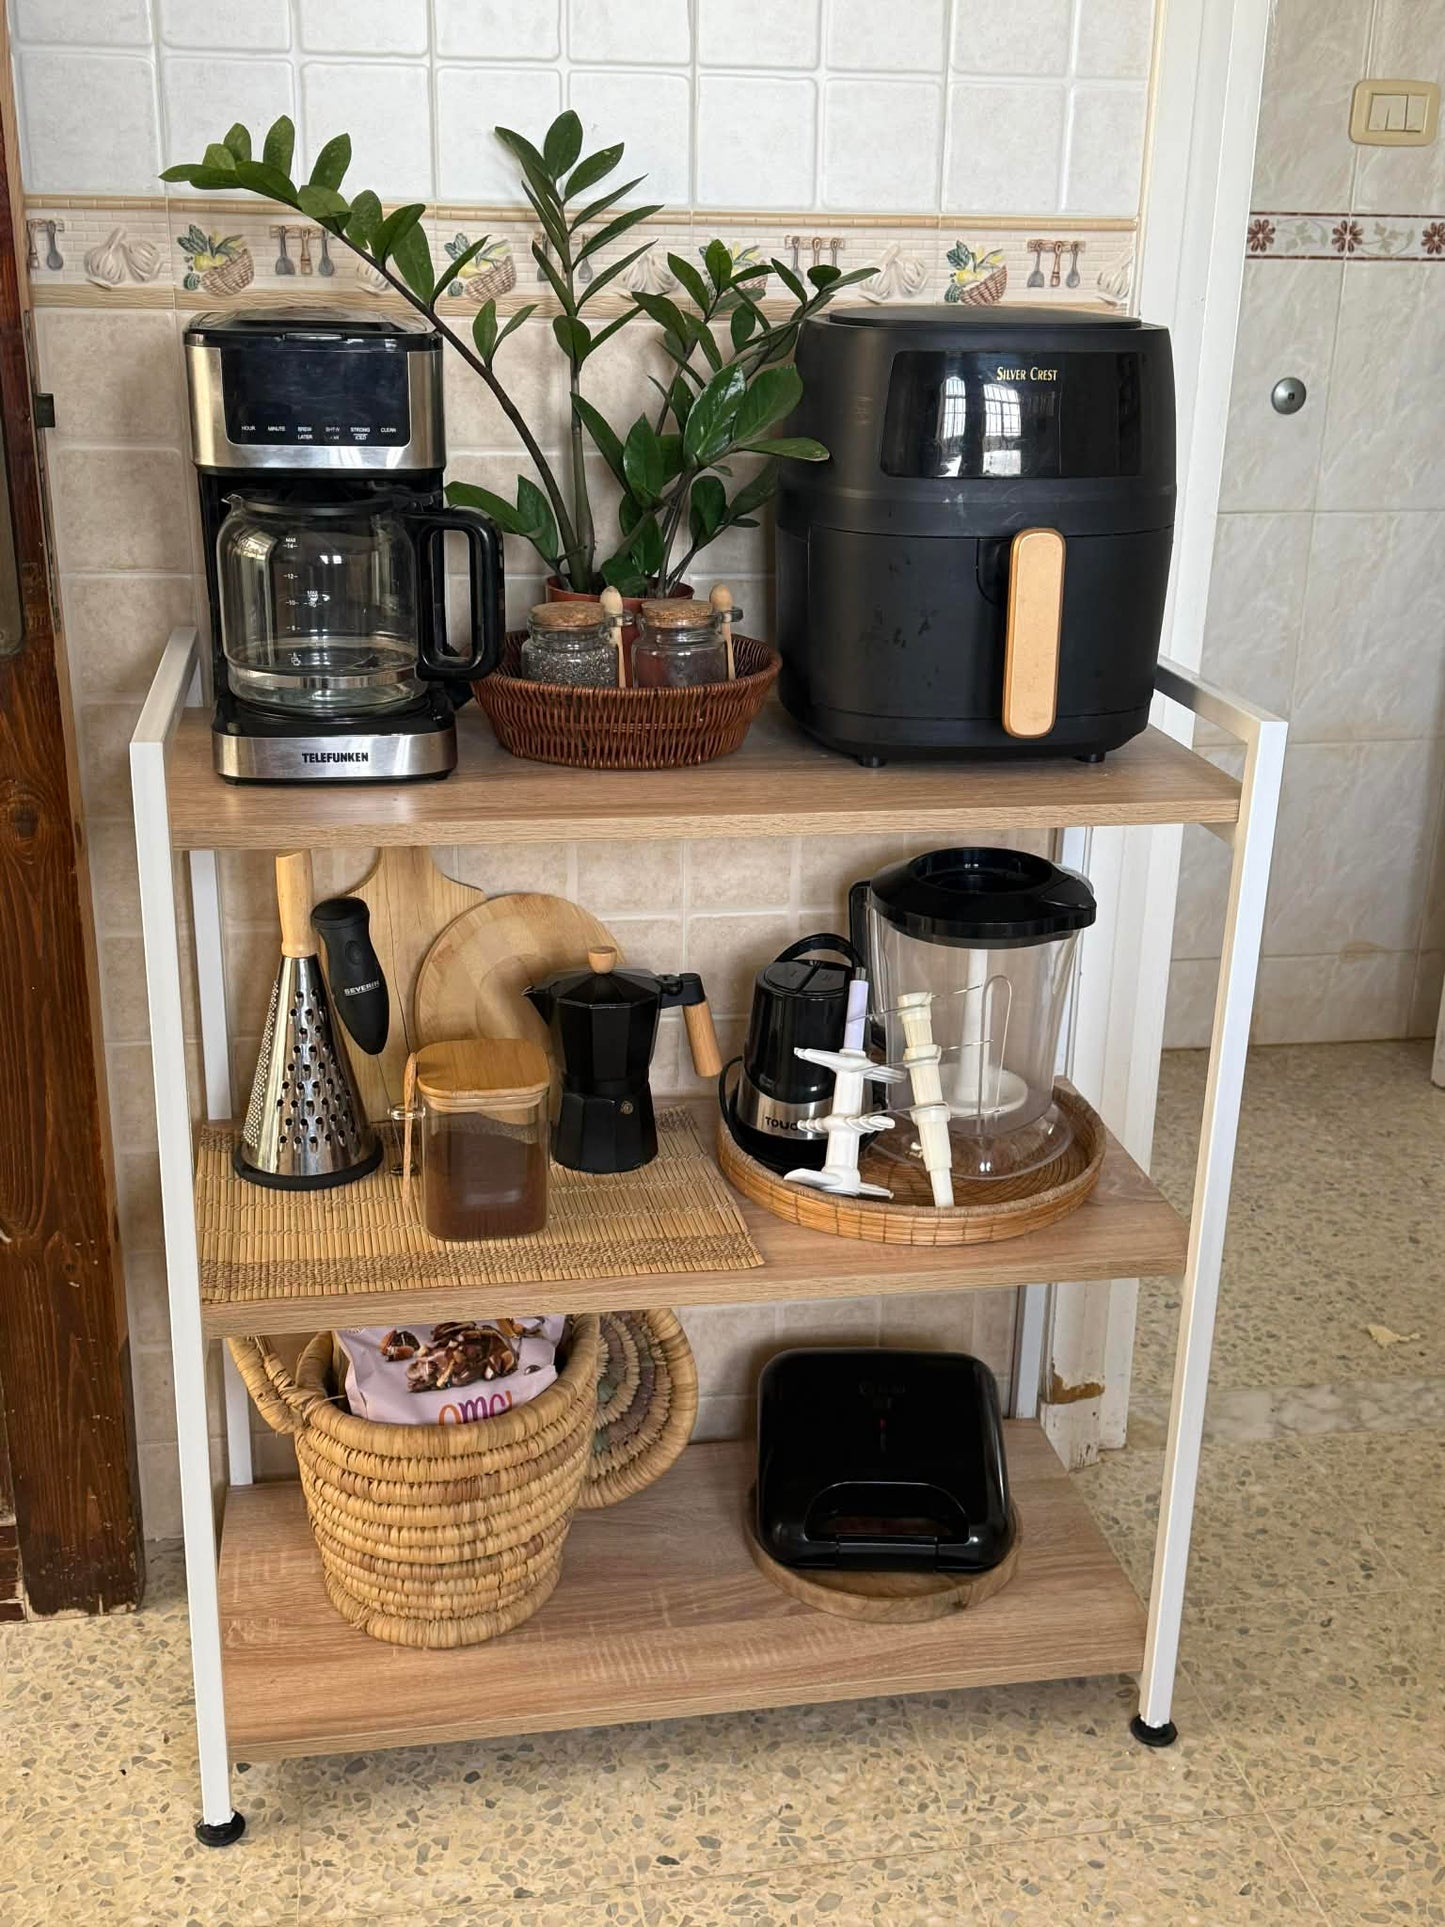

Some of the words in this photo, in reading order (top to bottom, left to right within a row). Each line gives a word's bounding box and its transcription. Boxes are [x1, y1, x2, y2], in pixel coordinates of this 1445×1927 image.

[996, 366, 1027, 381] SILVER
[1030, 366, 1058, 381] CREST
[301, 752, 369, 763] TELEFUNKEN
[344, 980, 379, 996] SEVERIN
